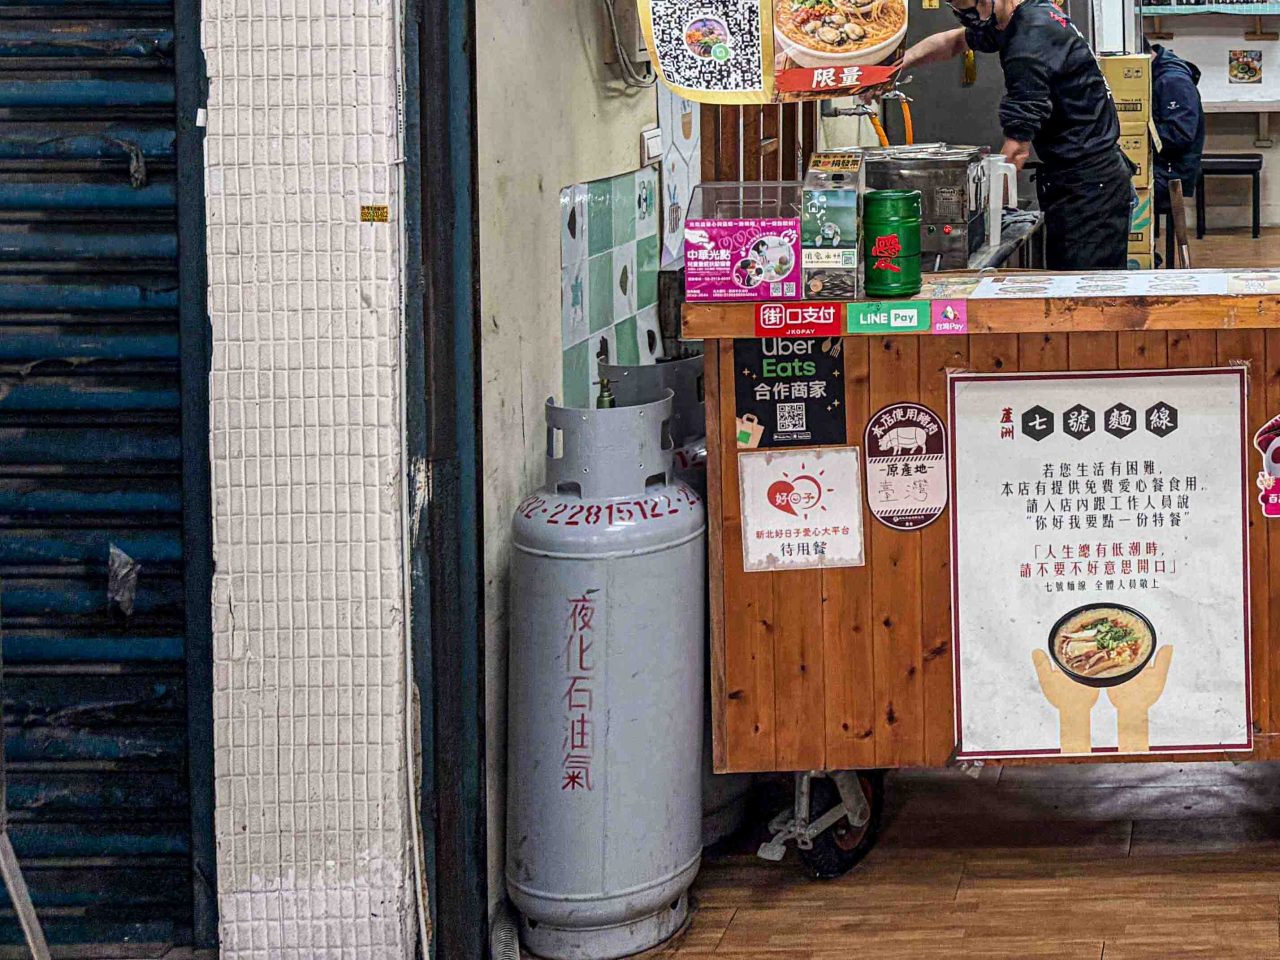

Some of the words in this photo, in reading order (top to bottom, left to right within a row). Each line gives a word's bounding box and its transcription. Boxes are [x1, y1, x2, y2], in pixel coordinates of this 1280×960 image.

[811, 68, 863, 88] 限量
[760, 304, 835, 328] 街口支付
[859, 312, 888, 325] LINE
[893, 311, 914, 326] Pay
[761, 337, 815, 356] Uber
[762, 358, 817, 378] Eats
[753, 381, 828, 401] 合作商家
[873, 407, 938, 437] 本店使用豬肉
[1000, 406, 1015, 440] 蘆洲
[1028, 407, 1174, 433] 七號麵線
[1026, 494, 1190, 514] 請入店內跟工作人員說
[756, 526, 850, 540] 新北好日子愛心大平台
[780, 541, 828, 557] 待用餐
